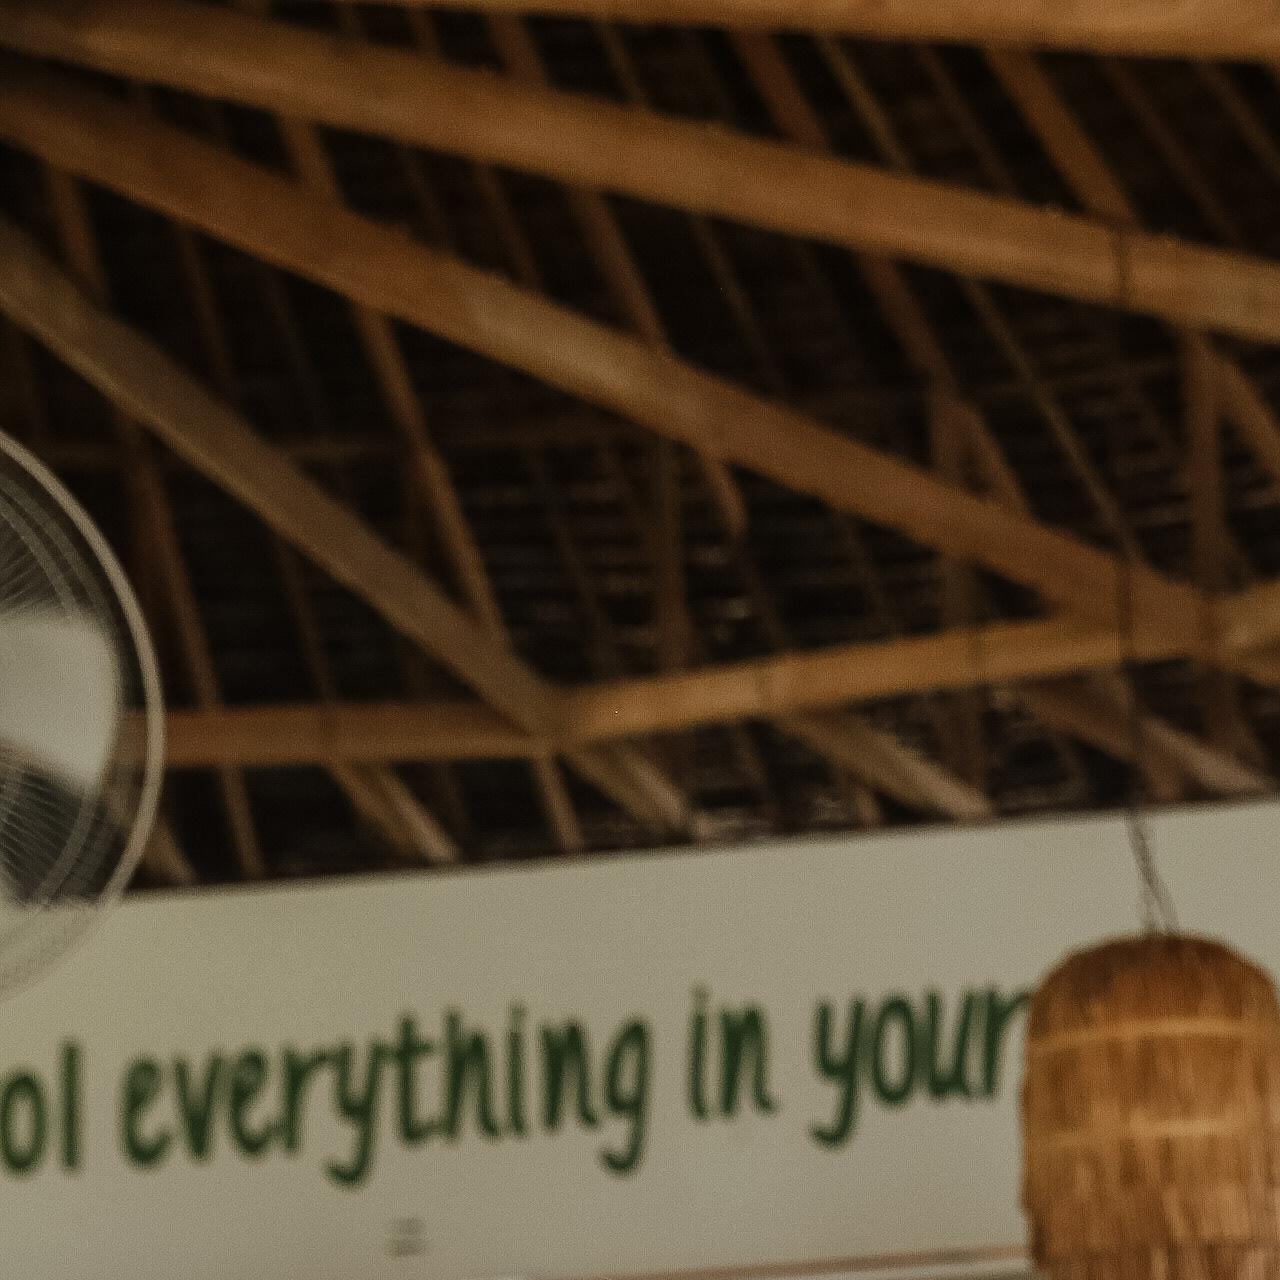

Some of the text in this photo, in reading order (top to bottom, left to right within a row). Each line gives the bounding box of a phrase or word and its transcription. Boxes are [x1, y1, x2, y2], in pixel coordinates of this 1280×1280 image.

[0, 1040, 85, 1178] ol
[117, 1006, 655, 1190] everything
[685, 988, 778, 1122] in
[808, 986, 1032, 1151] your
